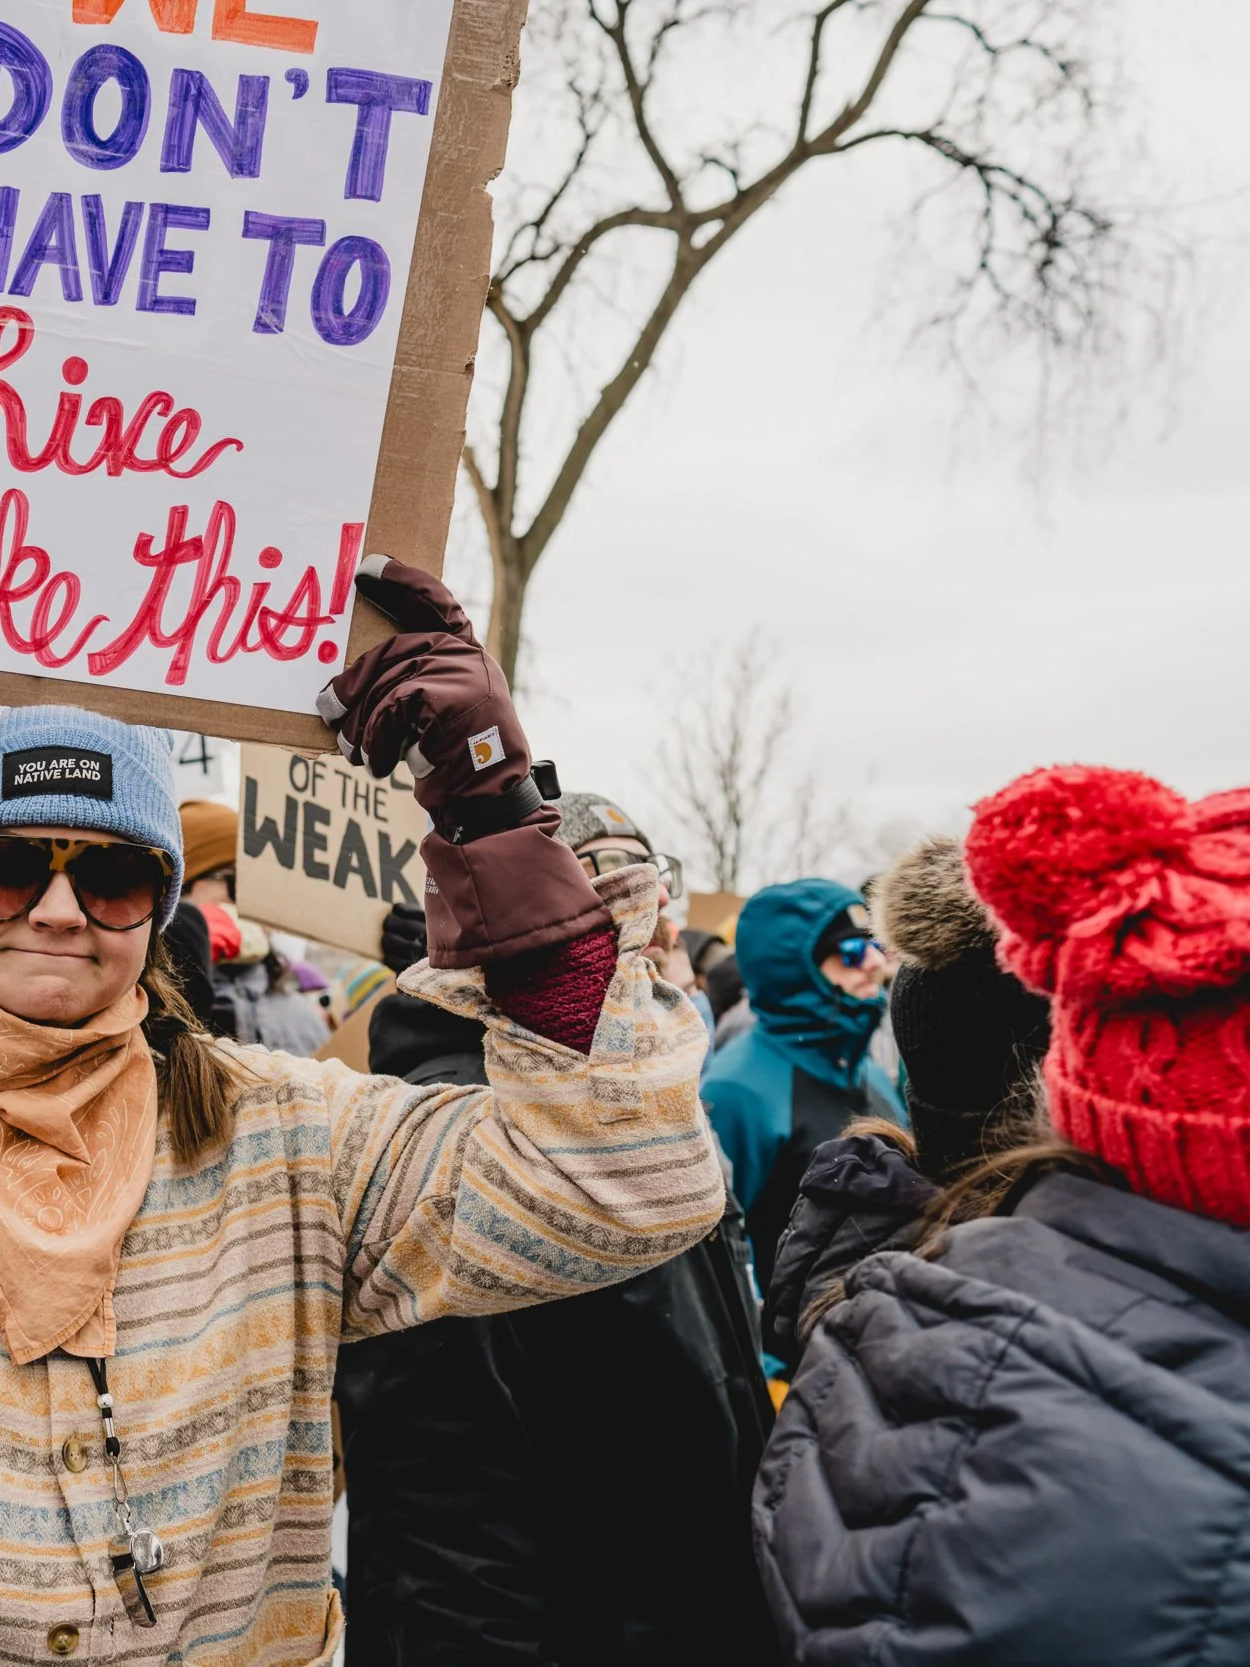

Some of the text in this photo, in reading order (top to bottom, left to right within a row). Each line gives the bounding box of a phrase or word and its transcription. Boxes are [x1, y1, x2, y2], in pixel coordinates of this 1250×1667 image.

[242, 210, 391, 346] TO
[87, 501, 364, 685] this!
[14, 768, 101, 785] NATIVE LAND
[18, 758, 100, 774] YOU ARE ON
[289, 755, 327, 798] OF
[334, 769, 388, 823] THE
[243, 775, 424, 909] WEAK
